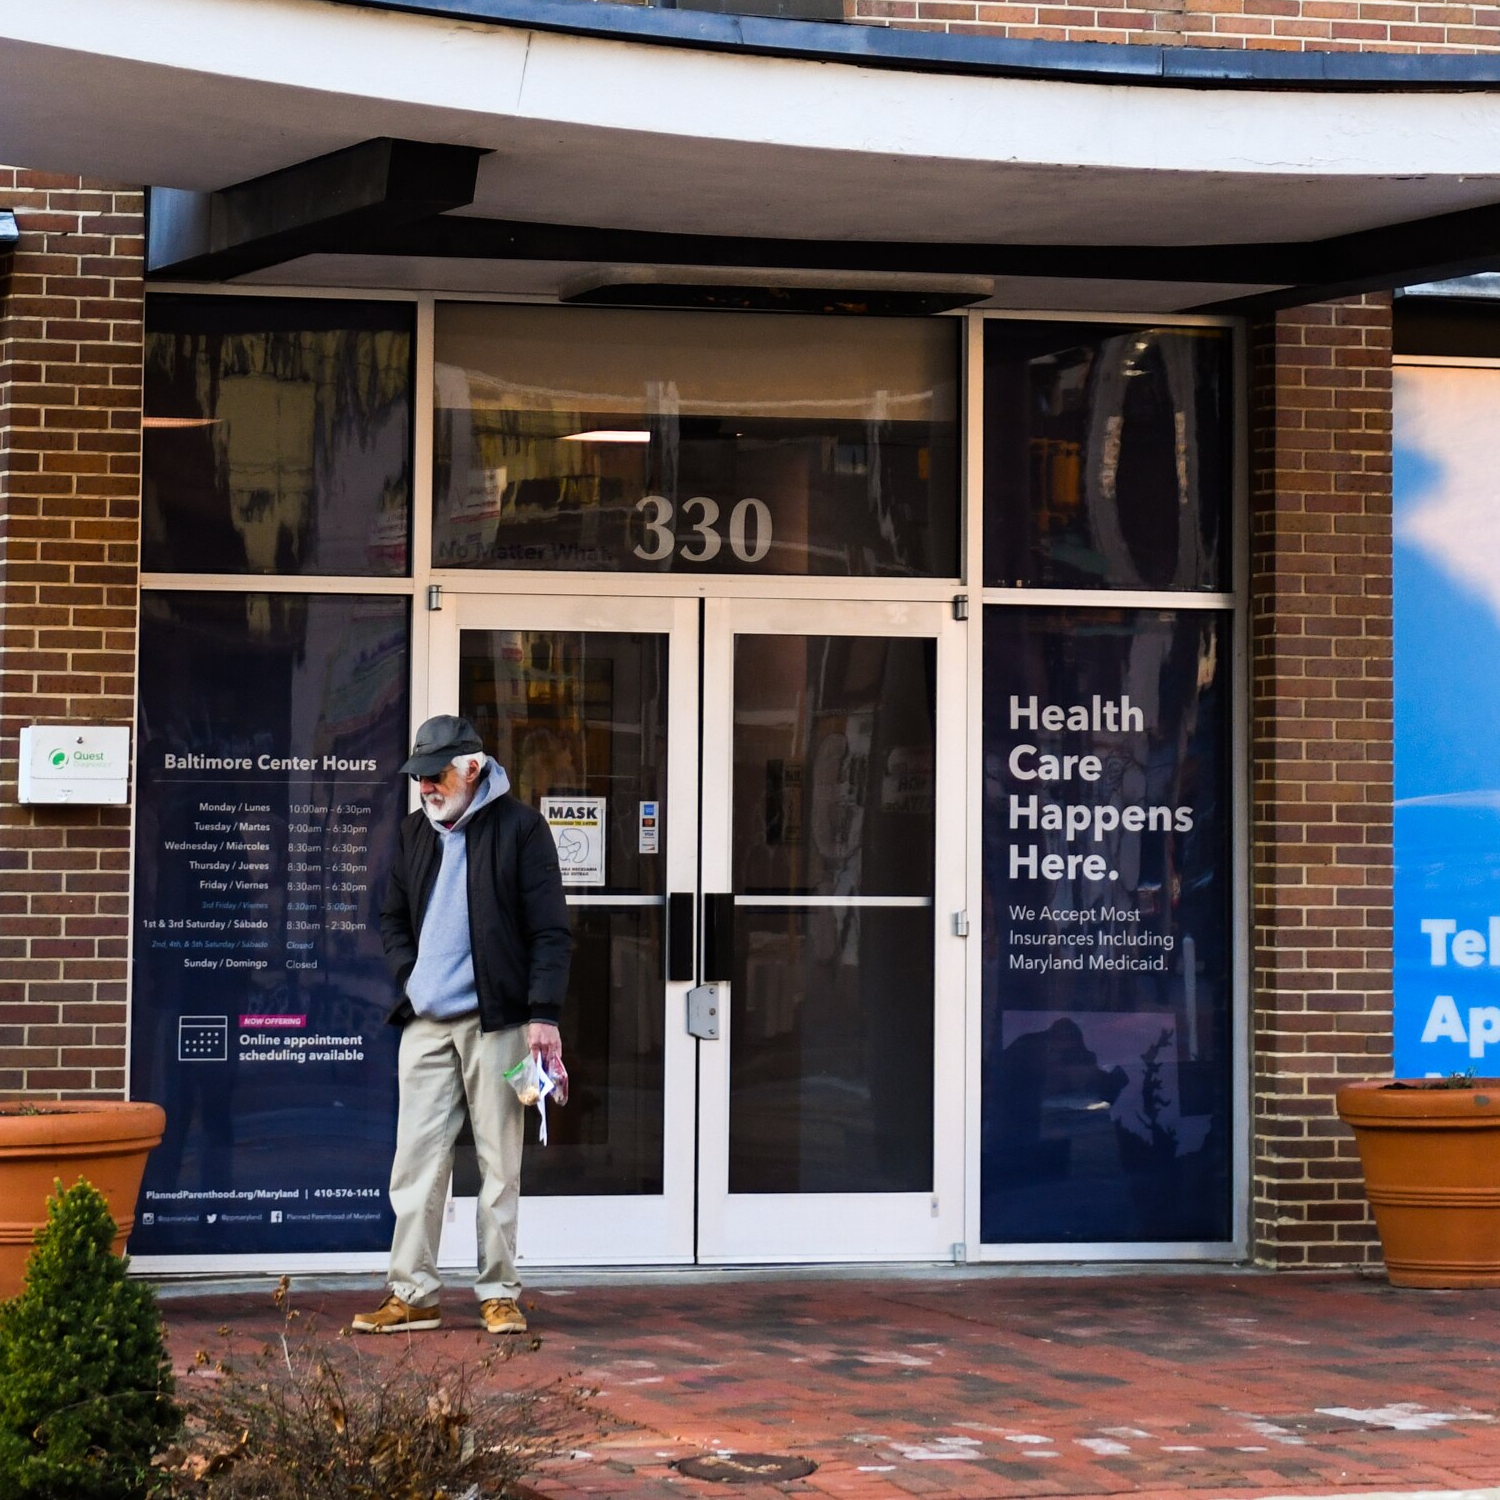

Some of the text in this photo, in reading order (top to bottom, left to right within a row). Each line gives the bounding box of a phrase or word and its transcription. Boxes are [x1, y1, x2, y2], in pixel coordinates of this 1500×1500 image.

[633, 495, 773, 563] 330
[477, 543, 544, 560] Matter
[1009, 695, 1144, 732] Health
[74, 751, 104, 760] Quest
[164, 753, 377, 772] Baltimore Center Hours
[1008, 745, 1102, 781] Care
[199, 802, 237, 814] Monday
[245, 803, 270, 812] Lunes
[289, 804, 328, 814] 10:00am
[336, 805, 371, 816] 6:30pm
[549, 807, 597, 819] MASK
[1008, 795, 1194, 842] Happens
[194, 822, 231, 834] Tuesday
[239, 822, 270, 831] Martes
[288, 824, 322, 834] 9:00am
[333, 824, 367, 836] 6:30pm
[165, 841, 218, 853] Wednesday
[226, 841, 270, 851] Miércoles
[288, 843, 321, 853] 8:30am
[332, 843, 367, 855] 6:30pm
[189, 861, 230, 873] Thursday
[238, 861, 269, 871] Jueves
[287, 862, 321, 872] 8:30am
[332, 862, 367, 874] 6:30pm
[1008, 845, 1119, 881] Here.
[200, 880, 227, 892] Friday
[235, 880, 269, 890] Viernes
[287, 881, 321, 892] 8:30am
[332, 882, 367, 893] 6:30pm
[1009, 906, 1140, 925] We Accept Most
[143, 919, 159, 928] 1st
[160, 919, 169, 929] &
[172, 919, 184, 929] 3rd
[186, 919, 227, 931] Saturday
[235, 919, 268, 929] Sábado
[286, 920, 320, 930] 8:30am
[331, 921, 366, 932] 2:30pm
[286, 941, 313, 950] Closed
[1009, 931, 1174, 950] Insurances Including
[184, 959, 218, 970] Sunday
[226, 959, 268, 970] Domingo
[286, 959, 318, 970] Closed
[1009, 955, 1169, 974] Maryland Medicaid.
[239, 1034, 363, 1048] Online appointment
[239, 1049, 364, 1063] scheduling available
[146, 1189, 299, 1200] PlannedParenthood.org/Maryland
[314, 1189, 380, 1198] 410-576-1414
